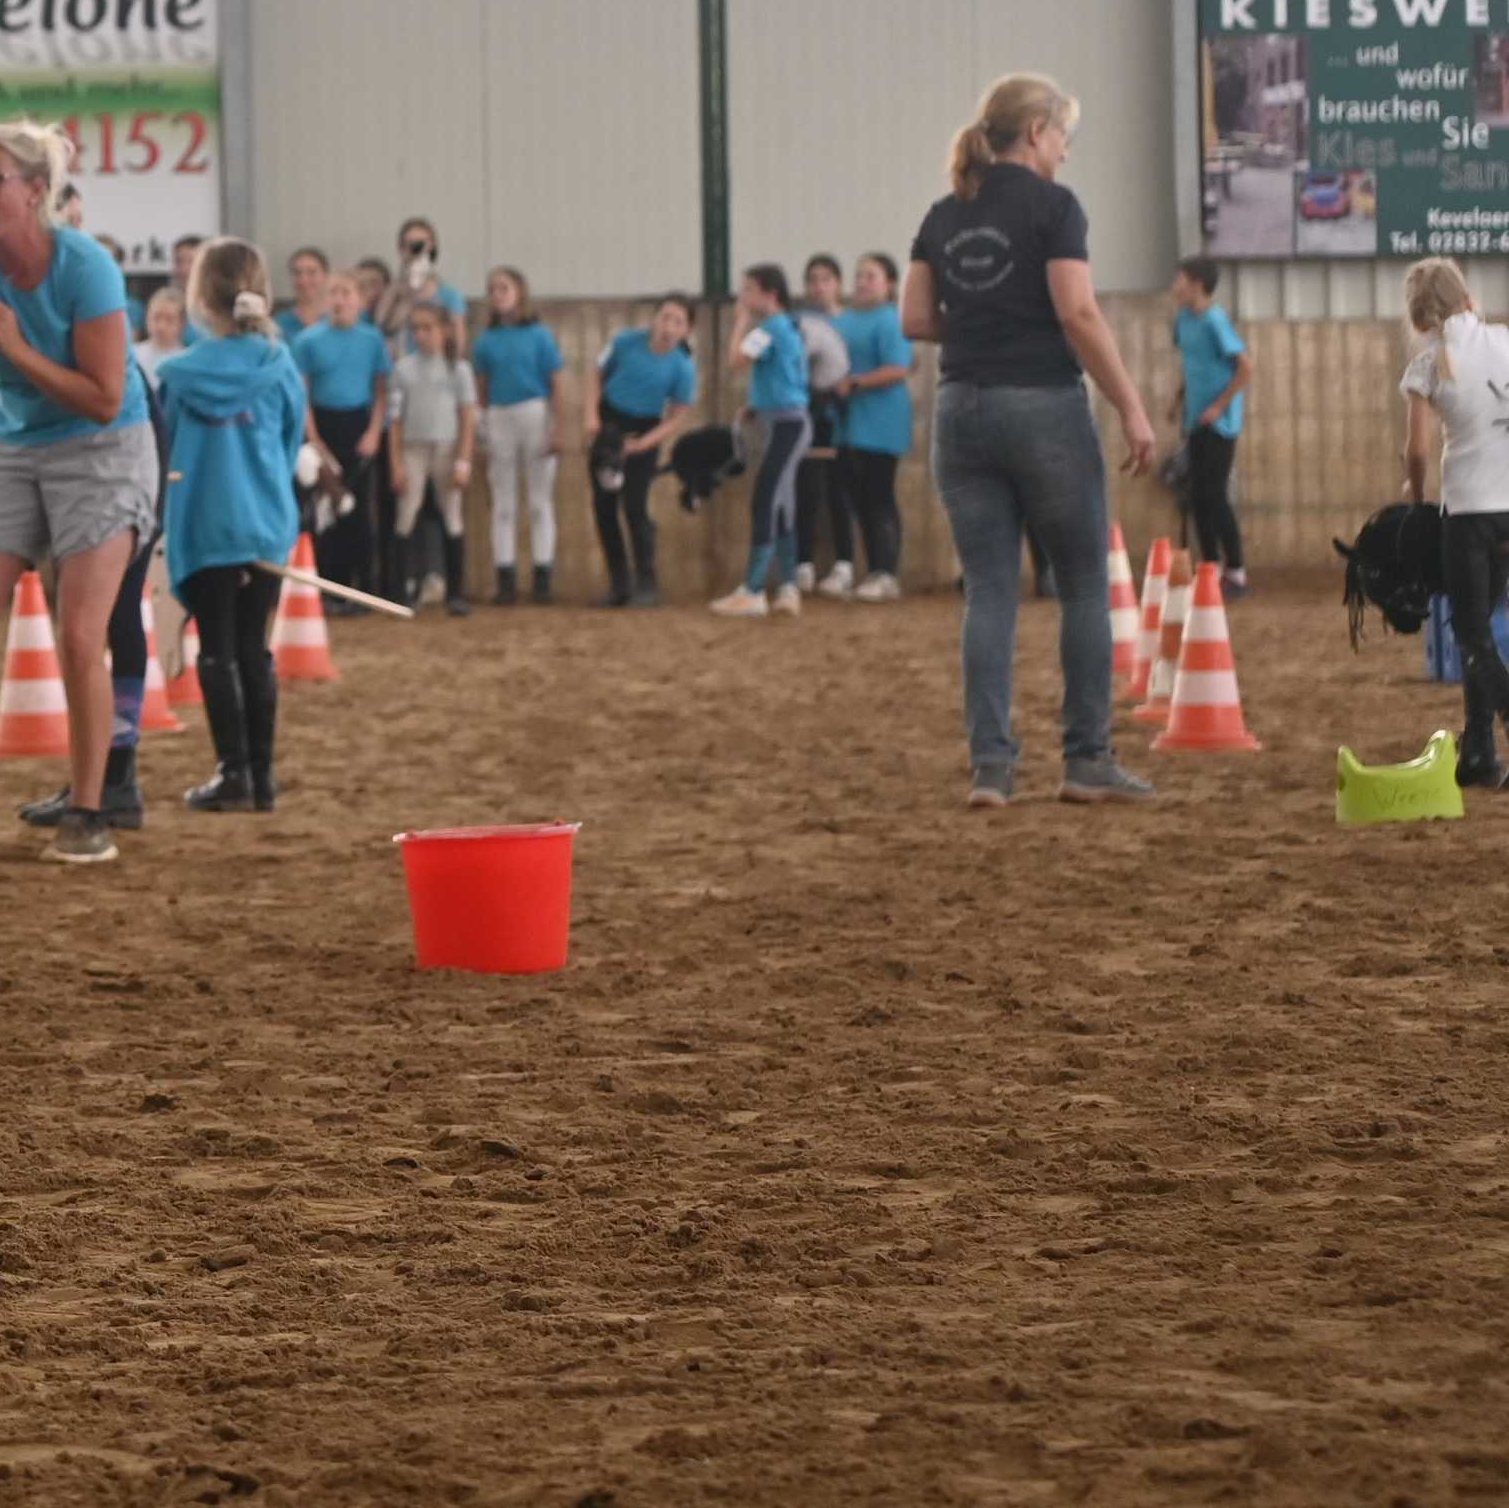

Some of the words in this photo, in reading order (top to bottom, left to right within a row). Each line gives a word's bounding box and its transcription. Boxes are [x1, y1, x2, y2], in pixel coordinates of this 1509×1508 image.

[1356, 41, 1399, 66] und
[1396, 61, 1469, 91] wofür
[1317, 93, 1441, 124] brauchen
[1442, 115, 1490, 151] Sie
